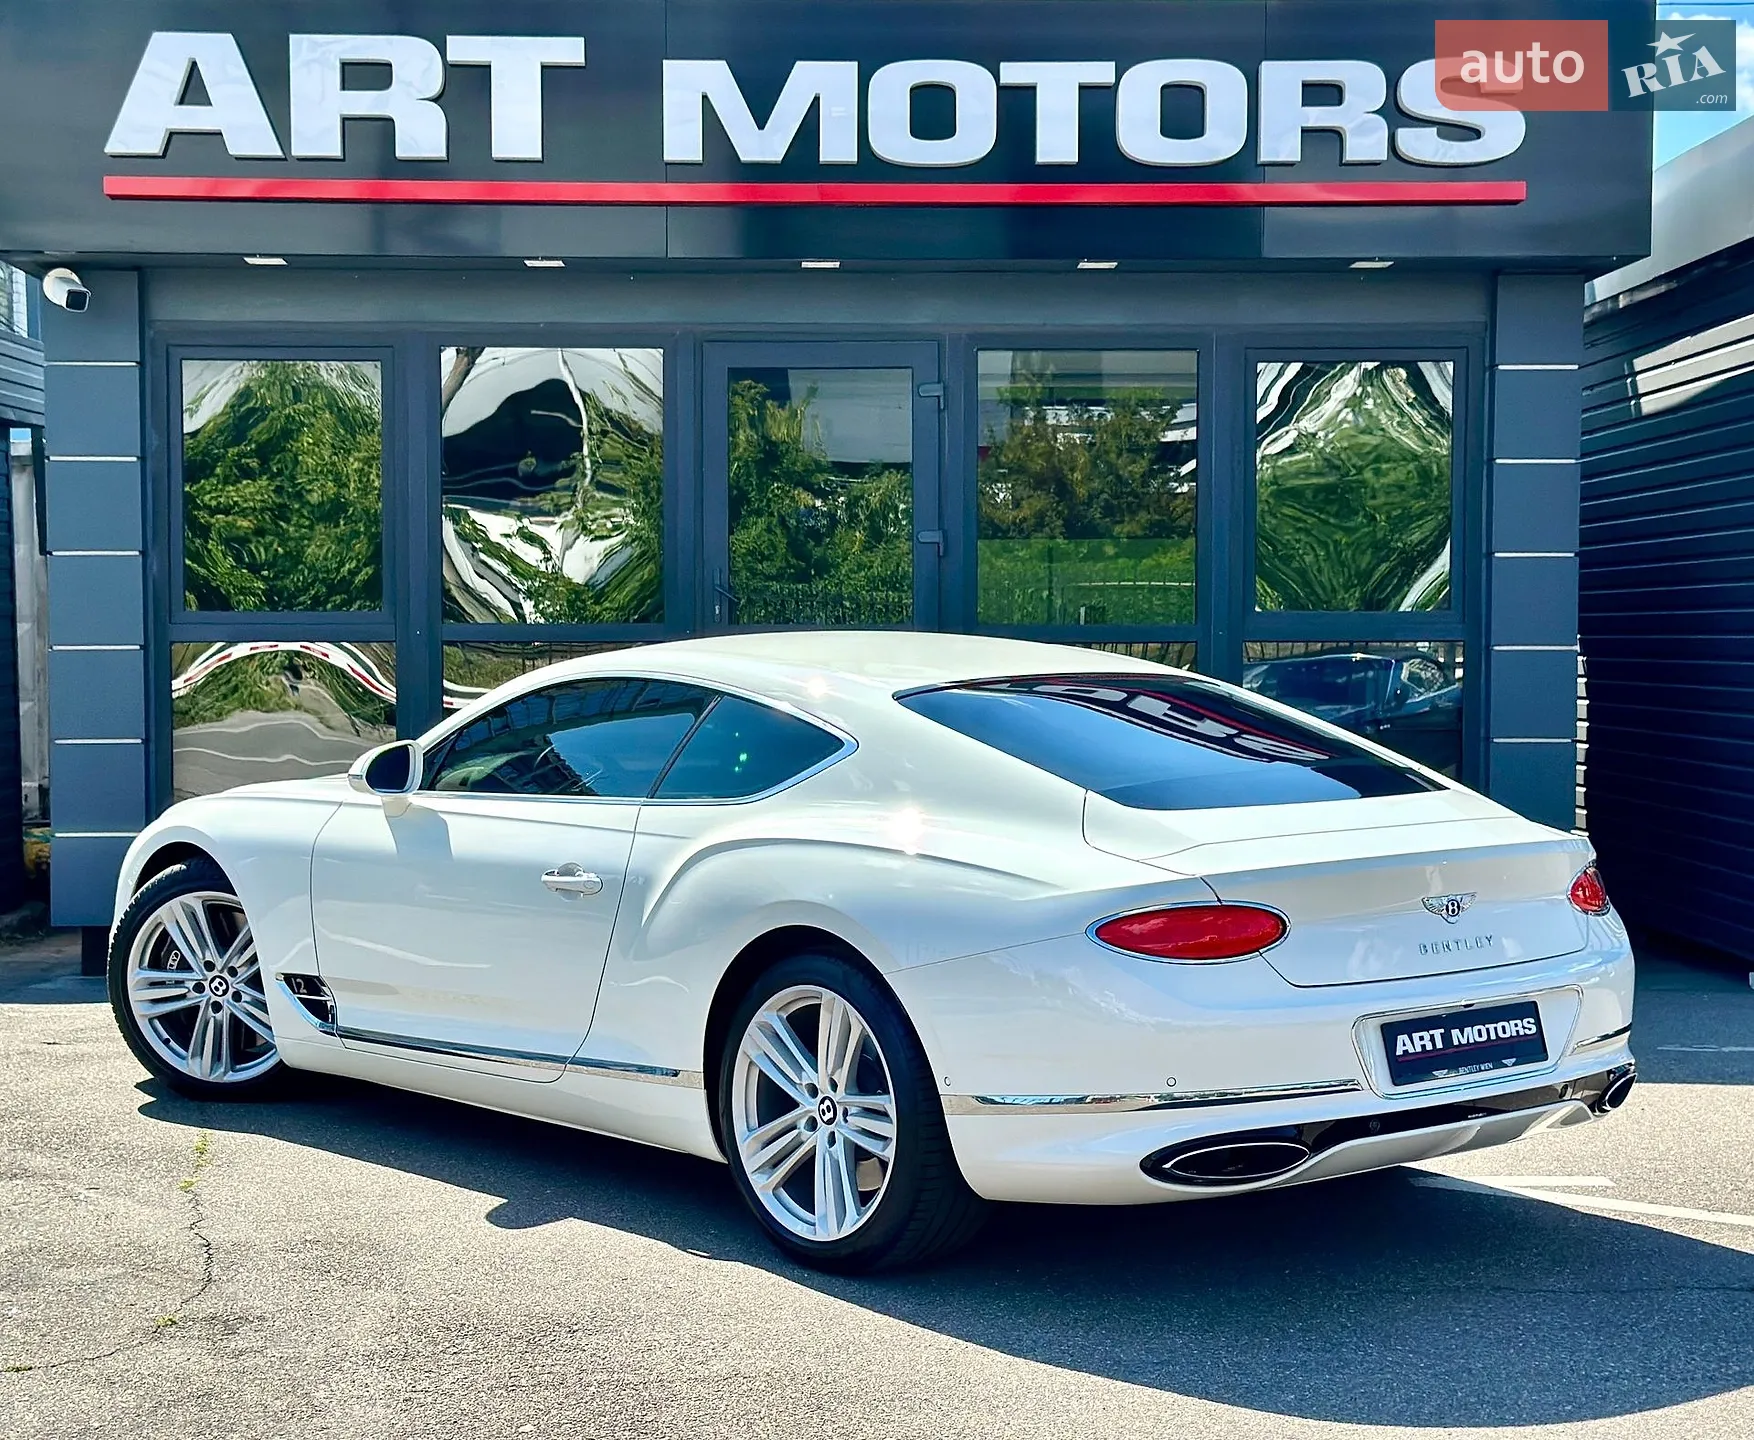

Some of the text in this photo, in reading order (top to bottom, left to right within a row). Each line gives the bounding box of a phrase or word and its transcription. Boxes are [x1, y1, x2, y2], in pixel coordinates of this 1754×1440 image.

[104, 31, 1527, 166] ART MOTORS
[1419, 934, 1493, 955] BENTLEY
[291, 977, 307, 994] 12
[1395, 1017, 1537, 1056] ART MOTORS
